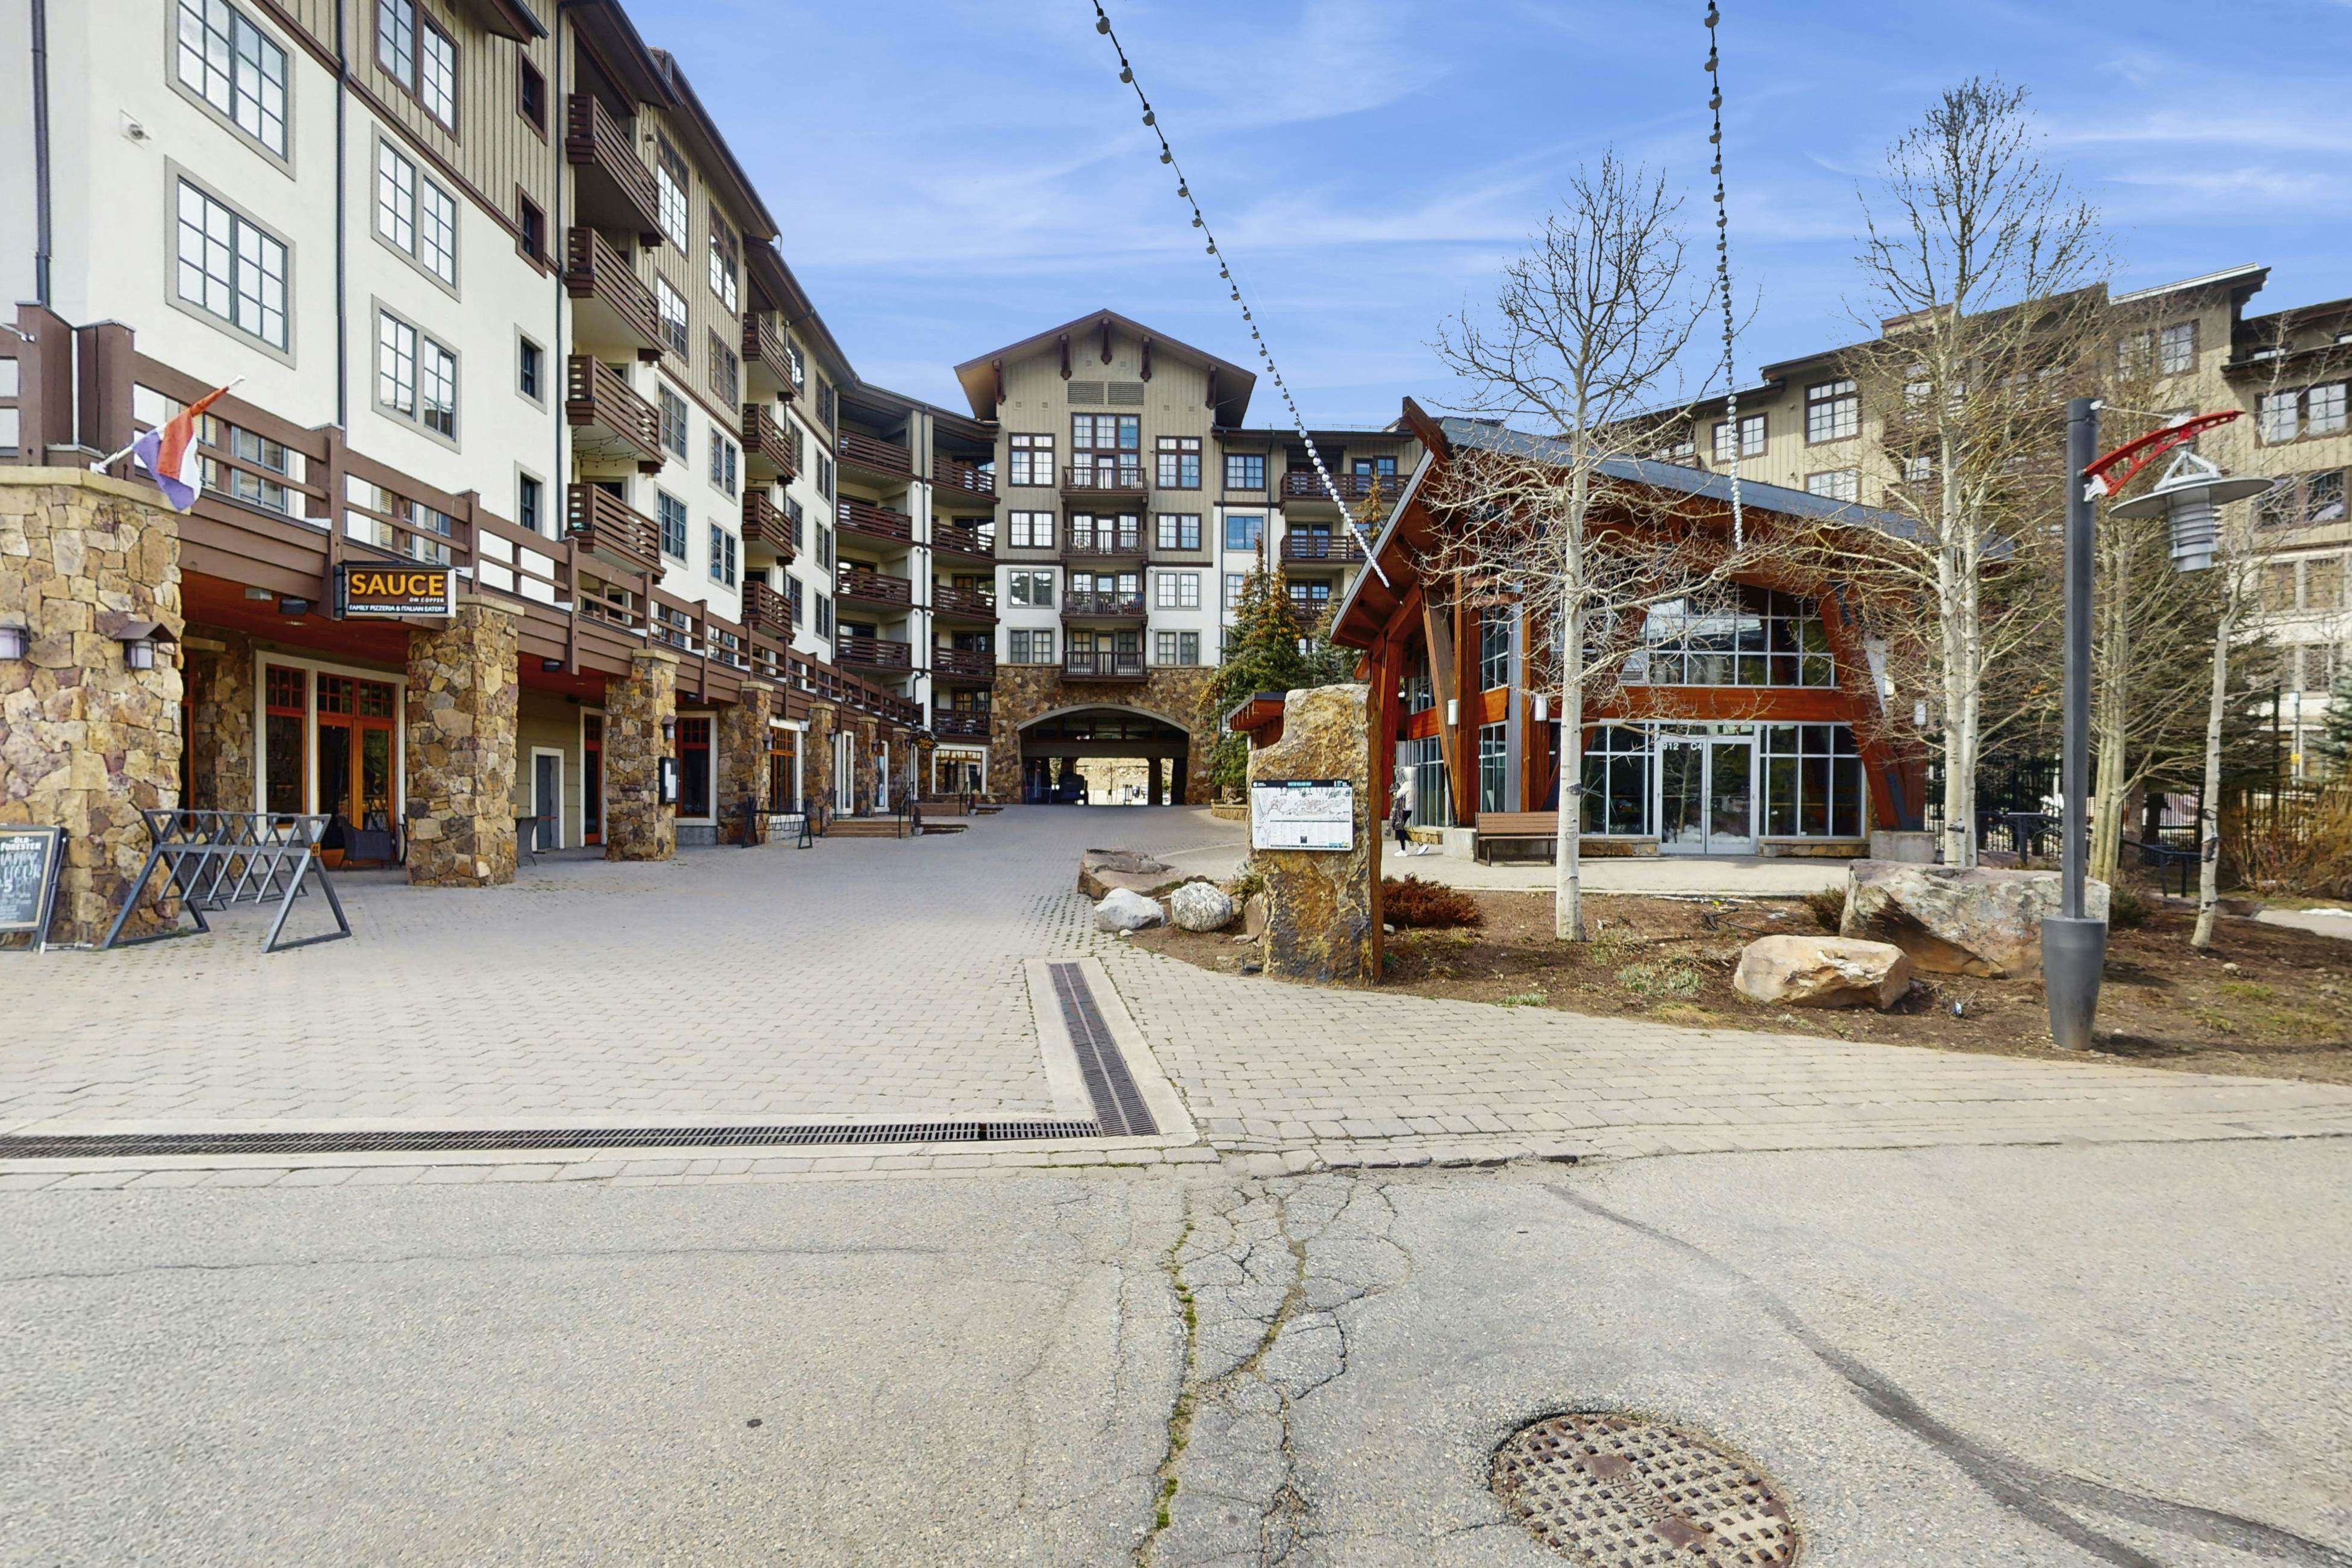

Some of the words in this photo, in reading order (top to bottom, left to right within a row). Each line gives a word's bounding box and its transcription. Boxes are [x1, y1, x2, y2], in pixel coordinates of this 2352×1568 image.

[351, 574, 444, 596] SAUCE
[1663, 742, 1679, 751] 912
[1691, 742, 1702, 751] C4
[1604, 1476, 1661, 1523] SEWER
[1621, 1472, 1678, 1519] STORM
